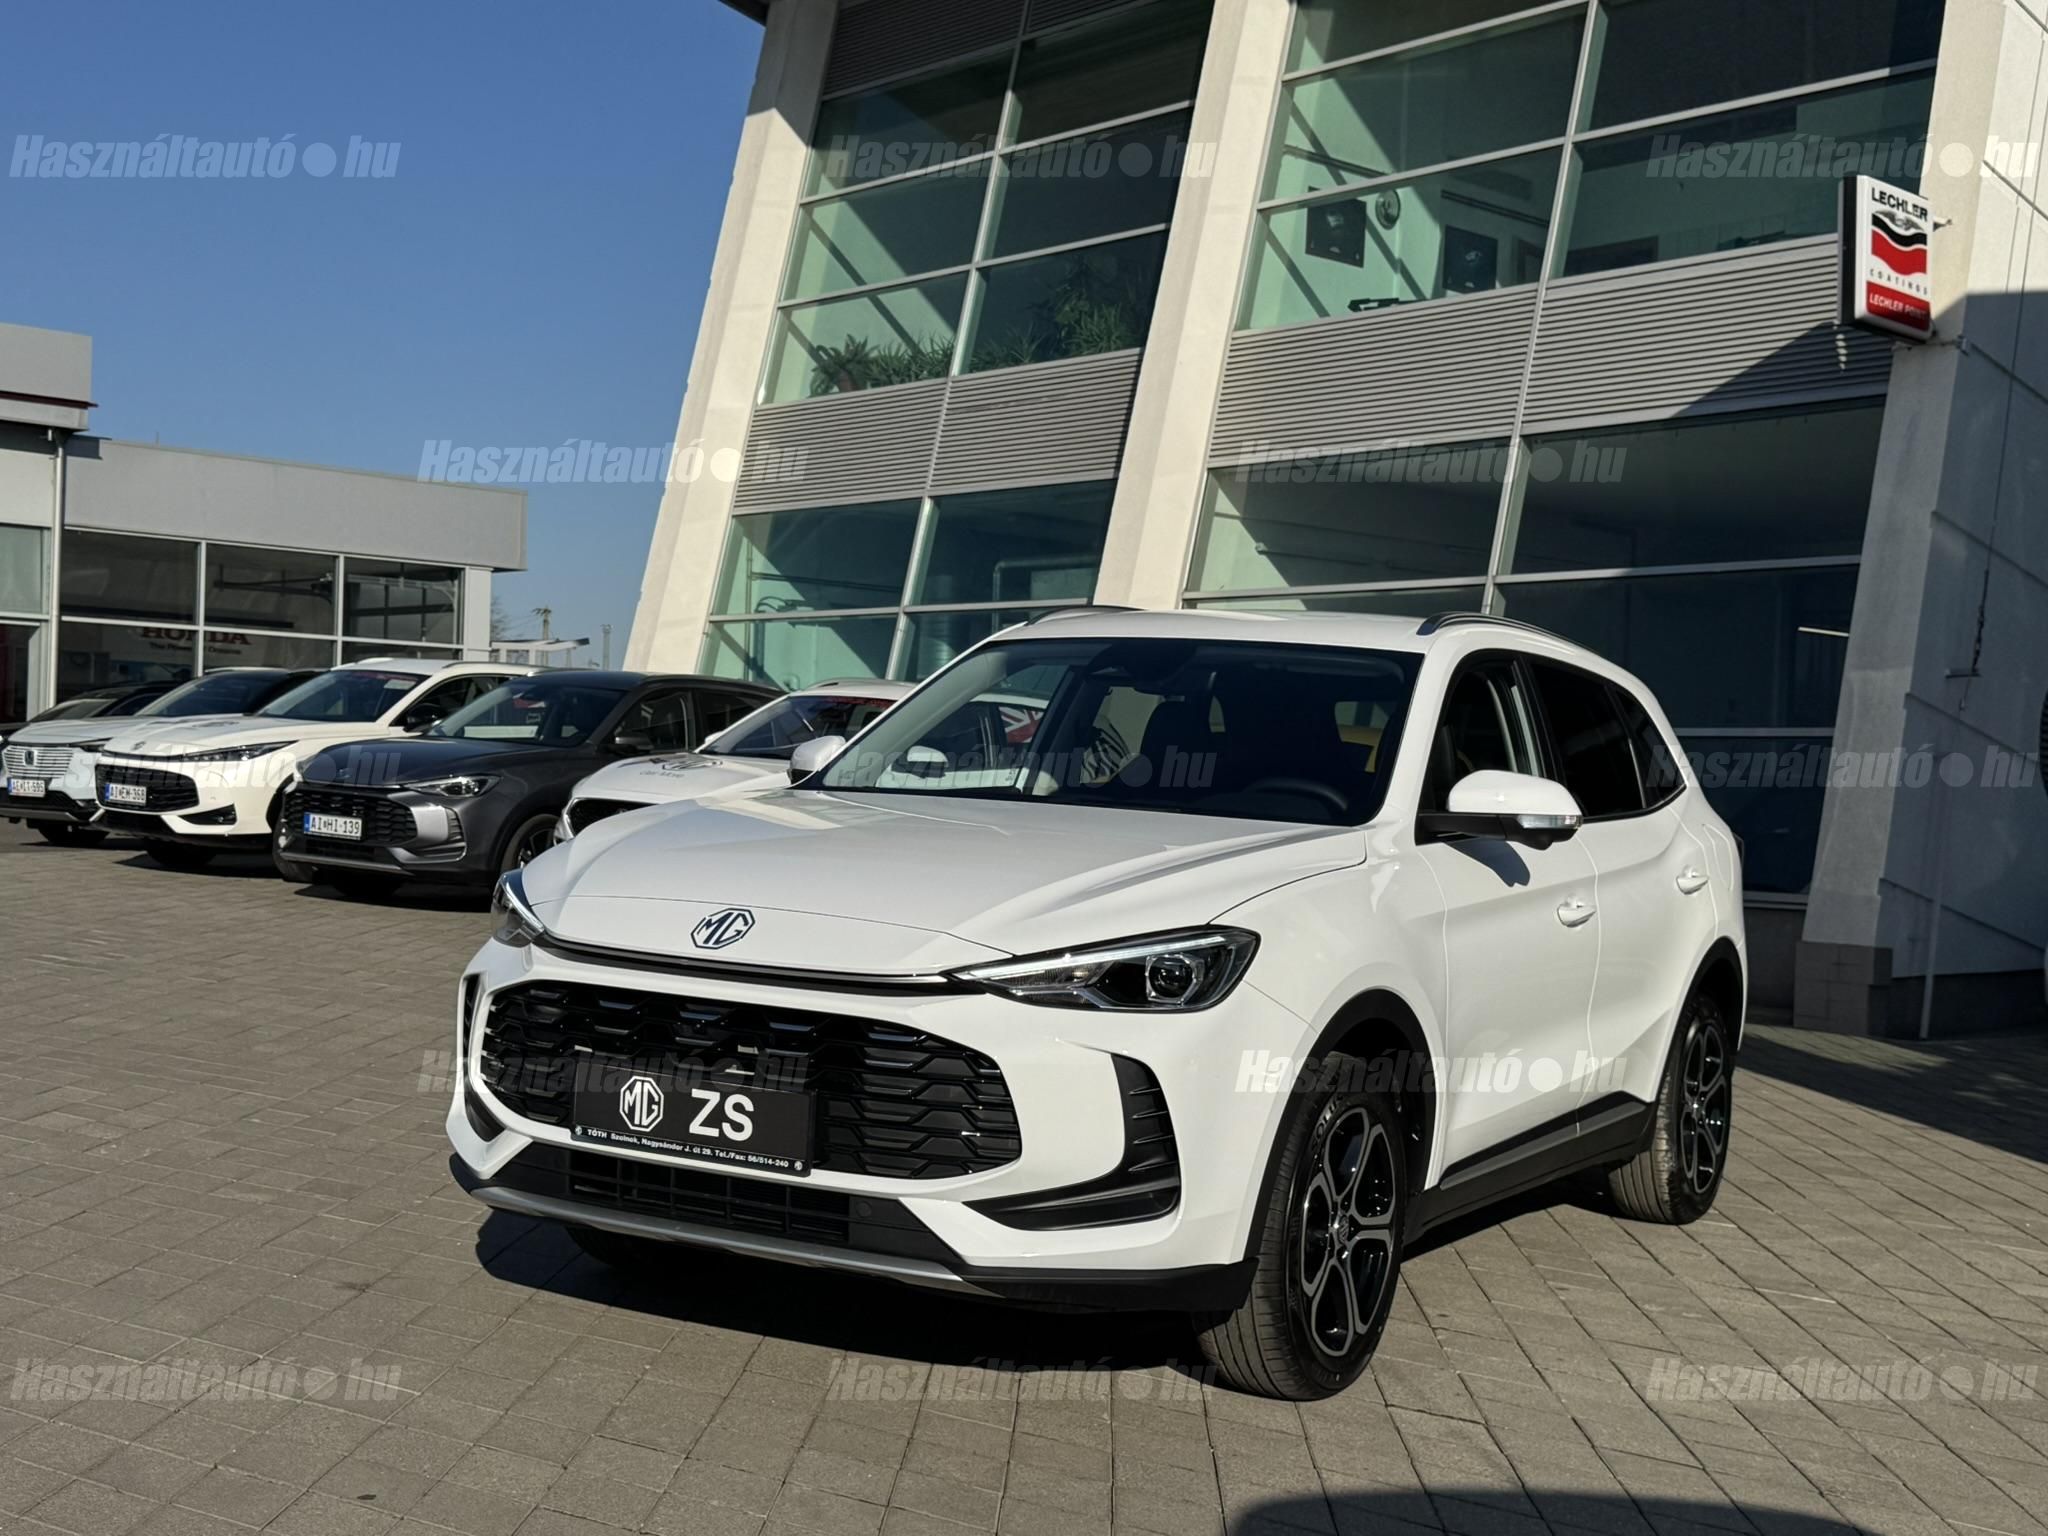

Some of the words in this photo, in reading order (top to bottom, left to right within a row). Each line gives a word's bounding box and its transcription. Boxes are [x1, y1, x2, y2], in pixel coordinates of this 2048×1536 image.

[1871, 186, 1929, 222] LECHLER
[1869, 268, 1928, 296] COATINGS
[1869, 292, 1904, 313] LECHLER
[693, 909, 754, 948] MG
[621, 1077, 662, 1129] MG
[689, 1087, 755, 1142] ZS
[587, 1128, 607, 1139] TÓTH
[611, 1132, 640, 1145] Szolnok,
